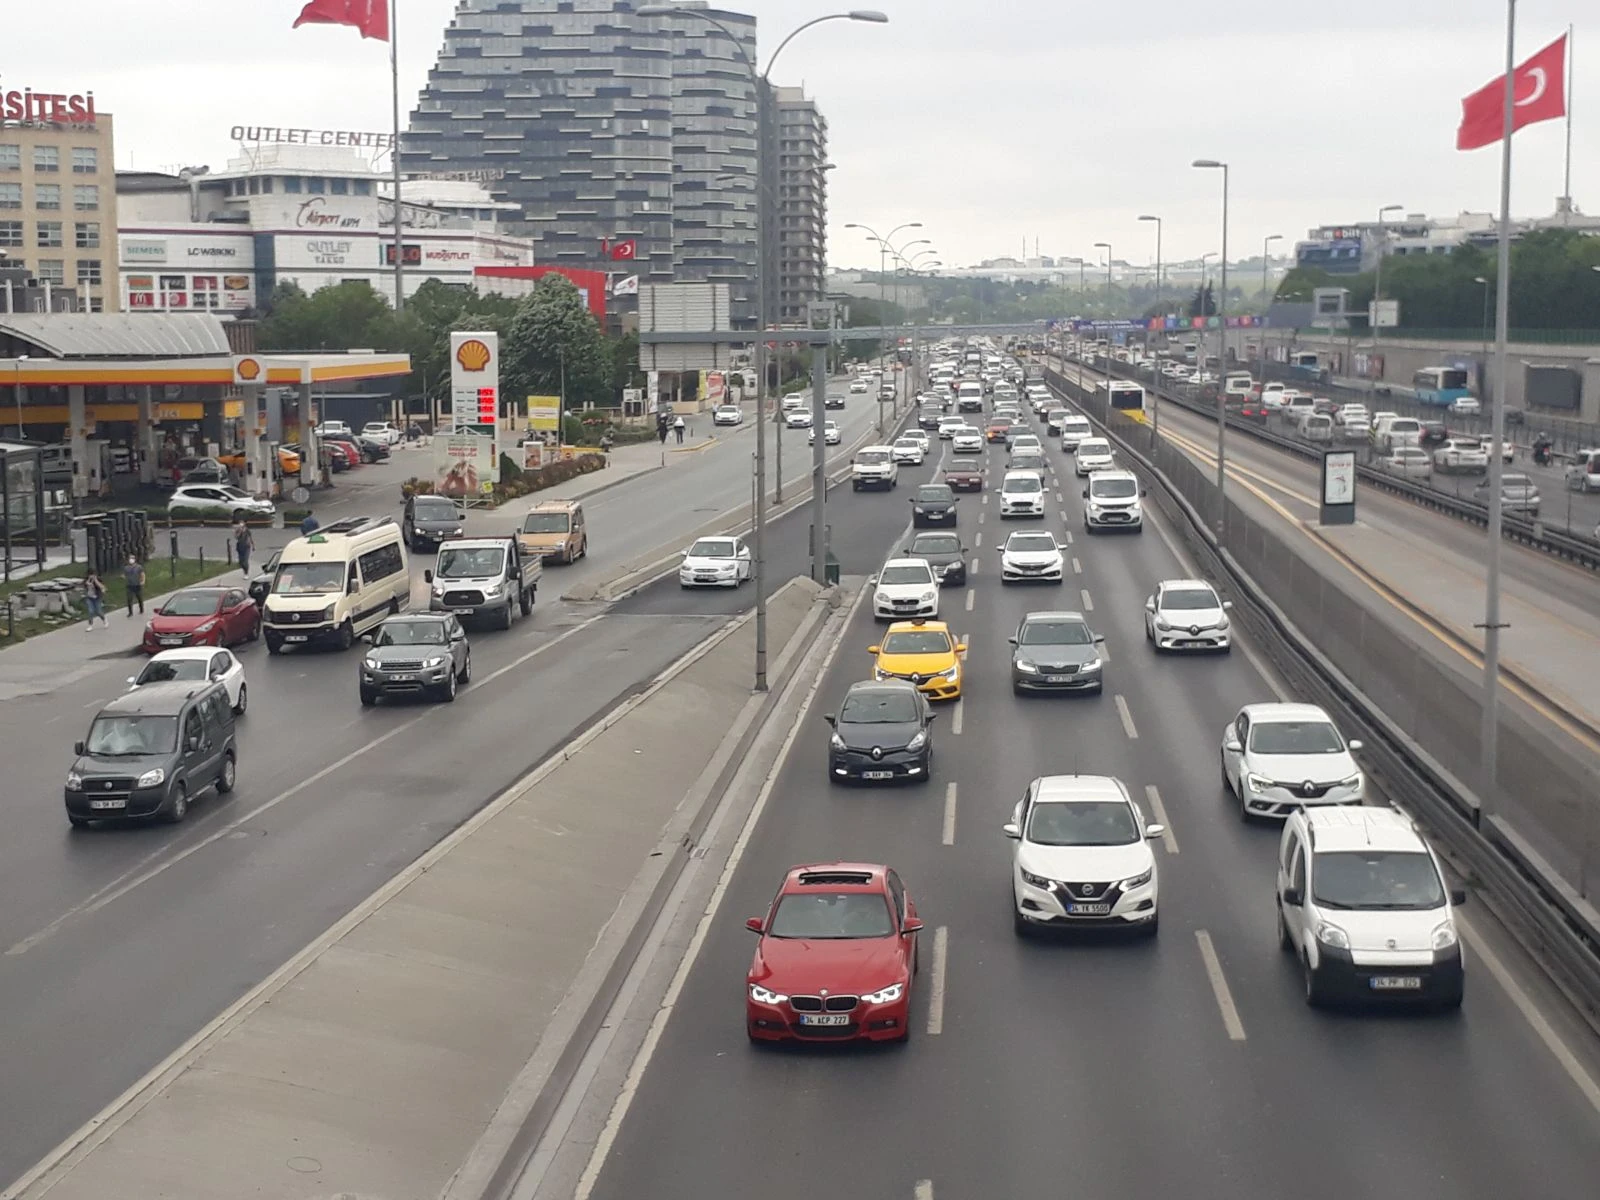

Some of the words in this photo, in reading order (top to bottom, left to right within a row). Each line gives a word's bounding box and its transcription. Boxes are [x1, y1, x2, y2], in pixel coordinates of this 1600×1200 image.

[0, 87, 96, 123] SİTESİ
[231, 126, 312, 144] OUTLET
[127, 247, 165, 255] SIEMENS
[187, 247, 200, 256] LC
[307, 241, 352, 253] OUTLET
[315, 256, 345, 264] TAKKO
[806, 1016, 814, 1024] 34
